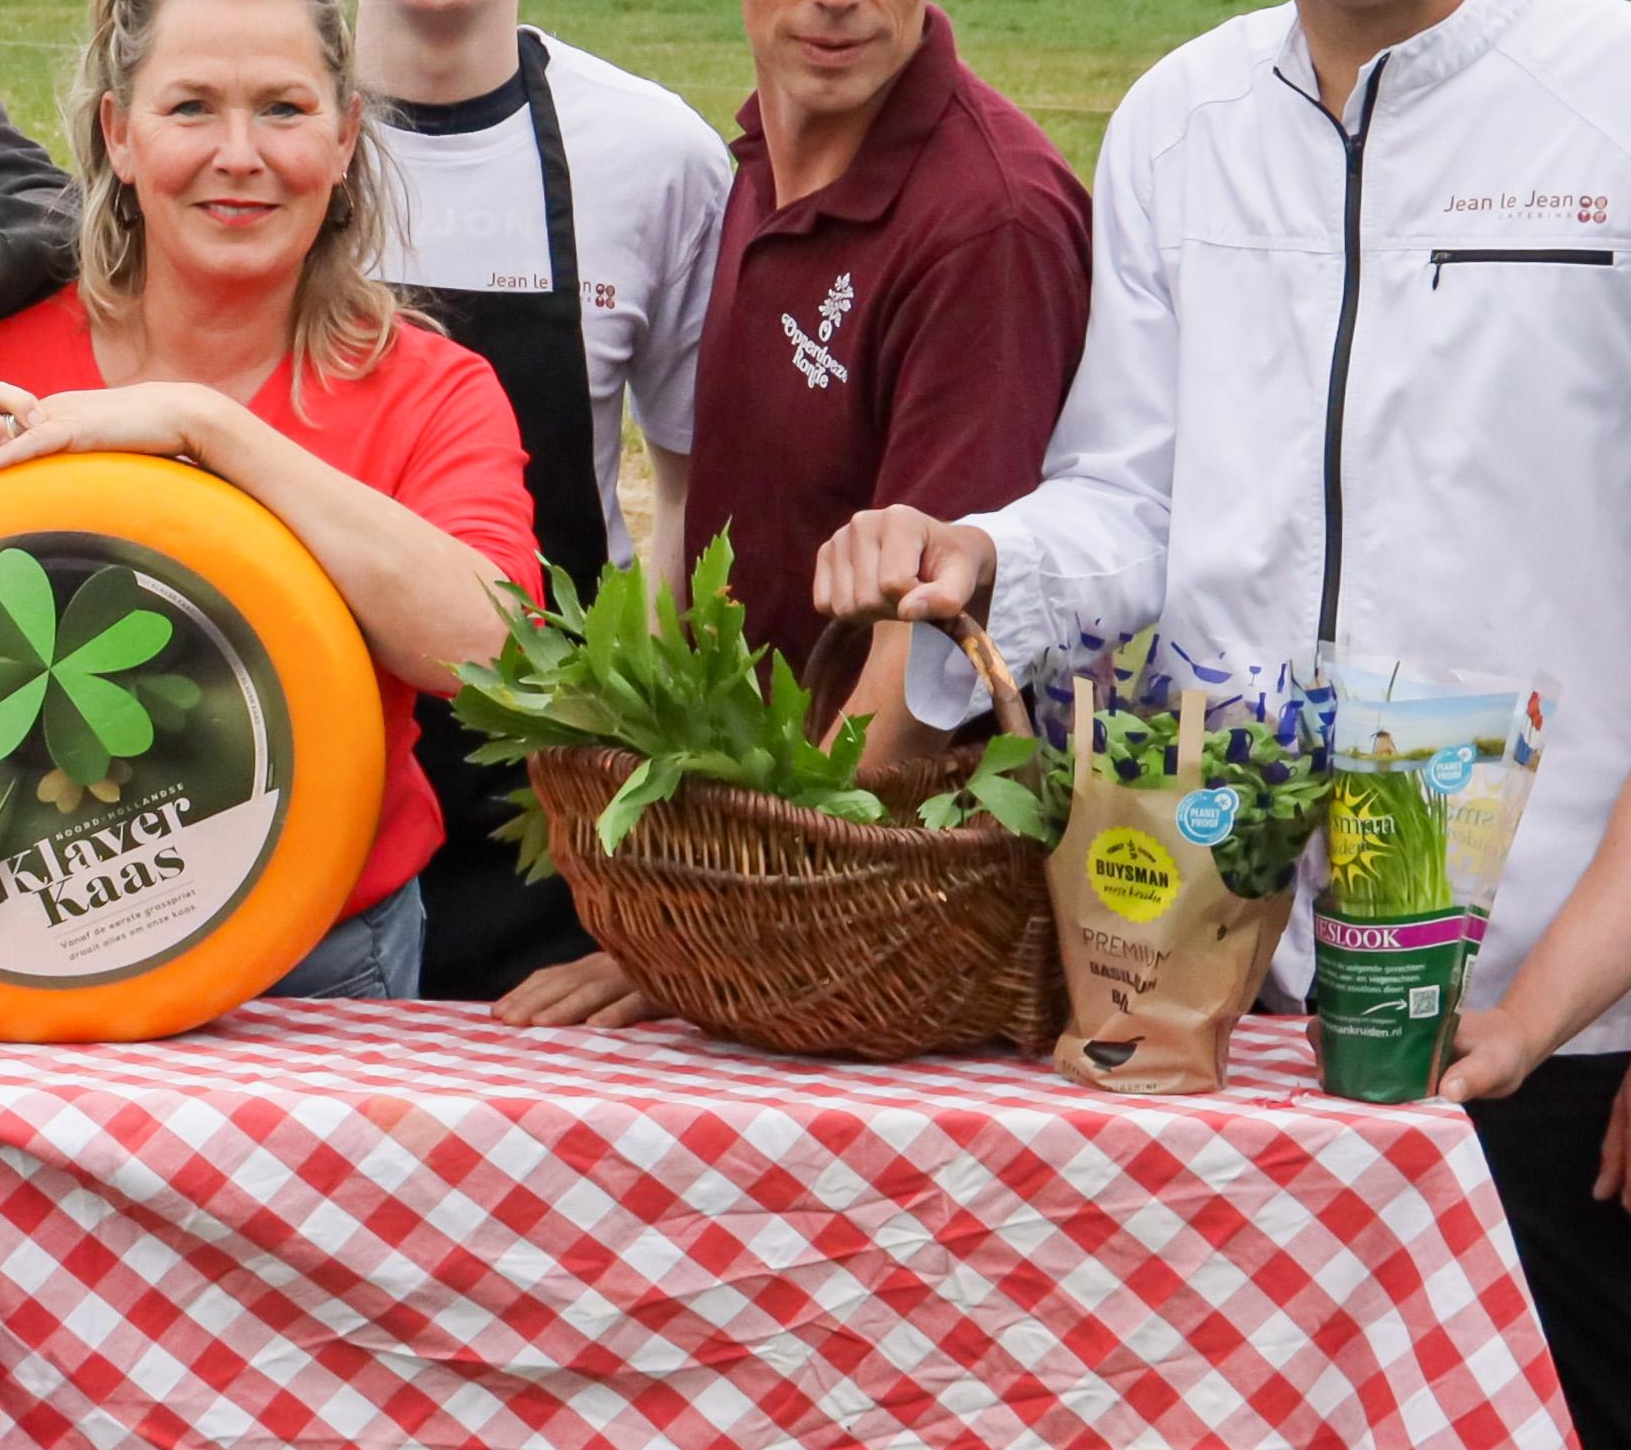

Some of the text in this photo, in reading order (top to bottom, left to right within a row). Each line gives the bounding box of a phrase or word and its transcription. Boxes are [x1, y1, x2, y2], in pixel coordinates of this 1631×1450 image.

[1443, 190, 1573, 213] Jean le Jean
[487, 272, 549, 289] Jean le
[55, 782, 185, 841] NOORD-HOLLANDSE
[1096, 859, 1169, 888] BUYSMAN
[60, 932, 91, 949] Vanaf
[93, 925, 106, 935] de
[108, 912, 141, 930] eerste
[68, 904, 196, 961] draait alles om onze kaas
